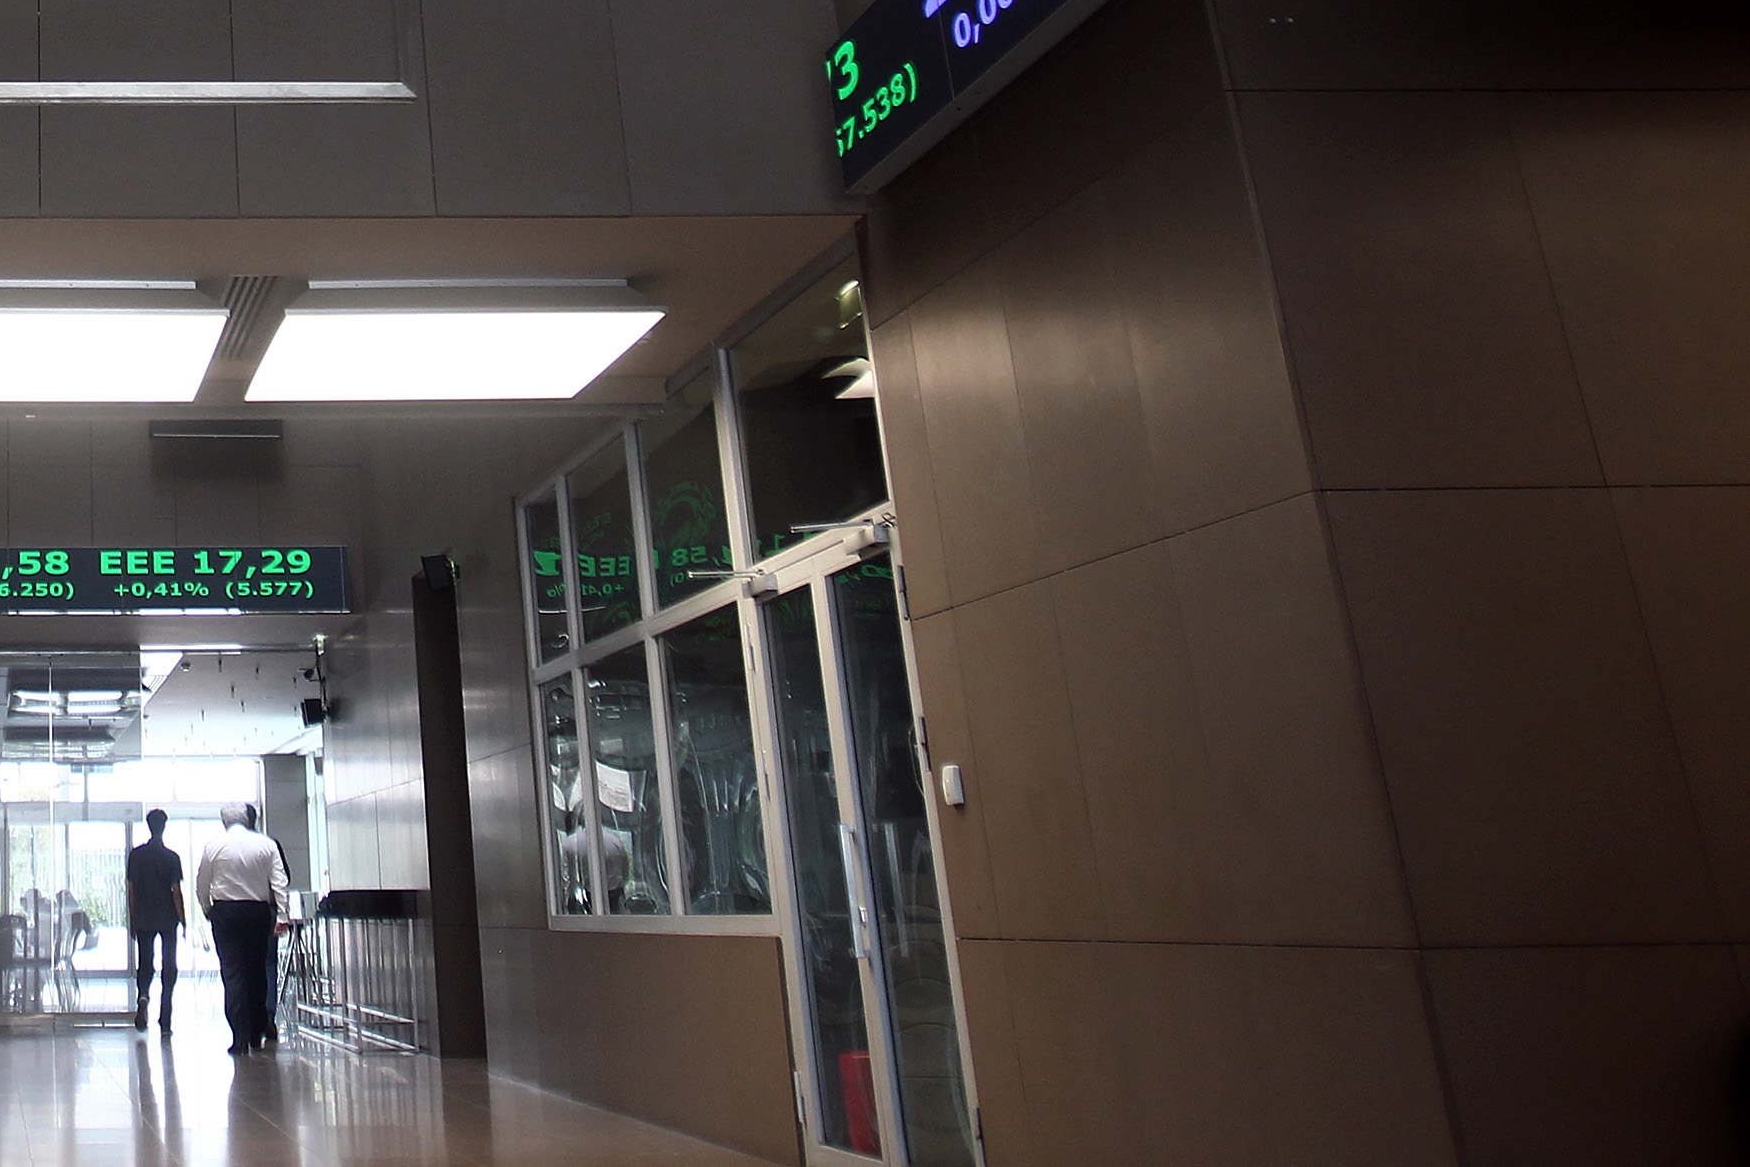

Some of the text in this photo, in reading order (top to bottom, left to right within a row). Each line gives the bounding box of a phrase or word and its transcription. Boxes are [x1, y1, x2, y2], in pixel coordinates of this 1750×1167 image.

[99, 550, 176, 575] ΕΕΕ
[193, 550, 312, 580] 17,29
[113, 581, 210, 599] +0,41%
[225, 581, 315, 600] (5.577)
